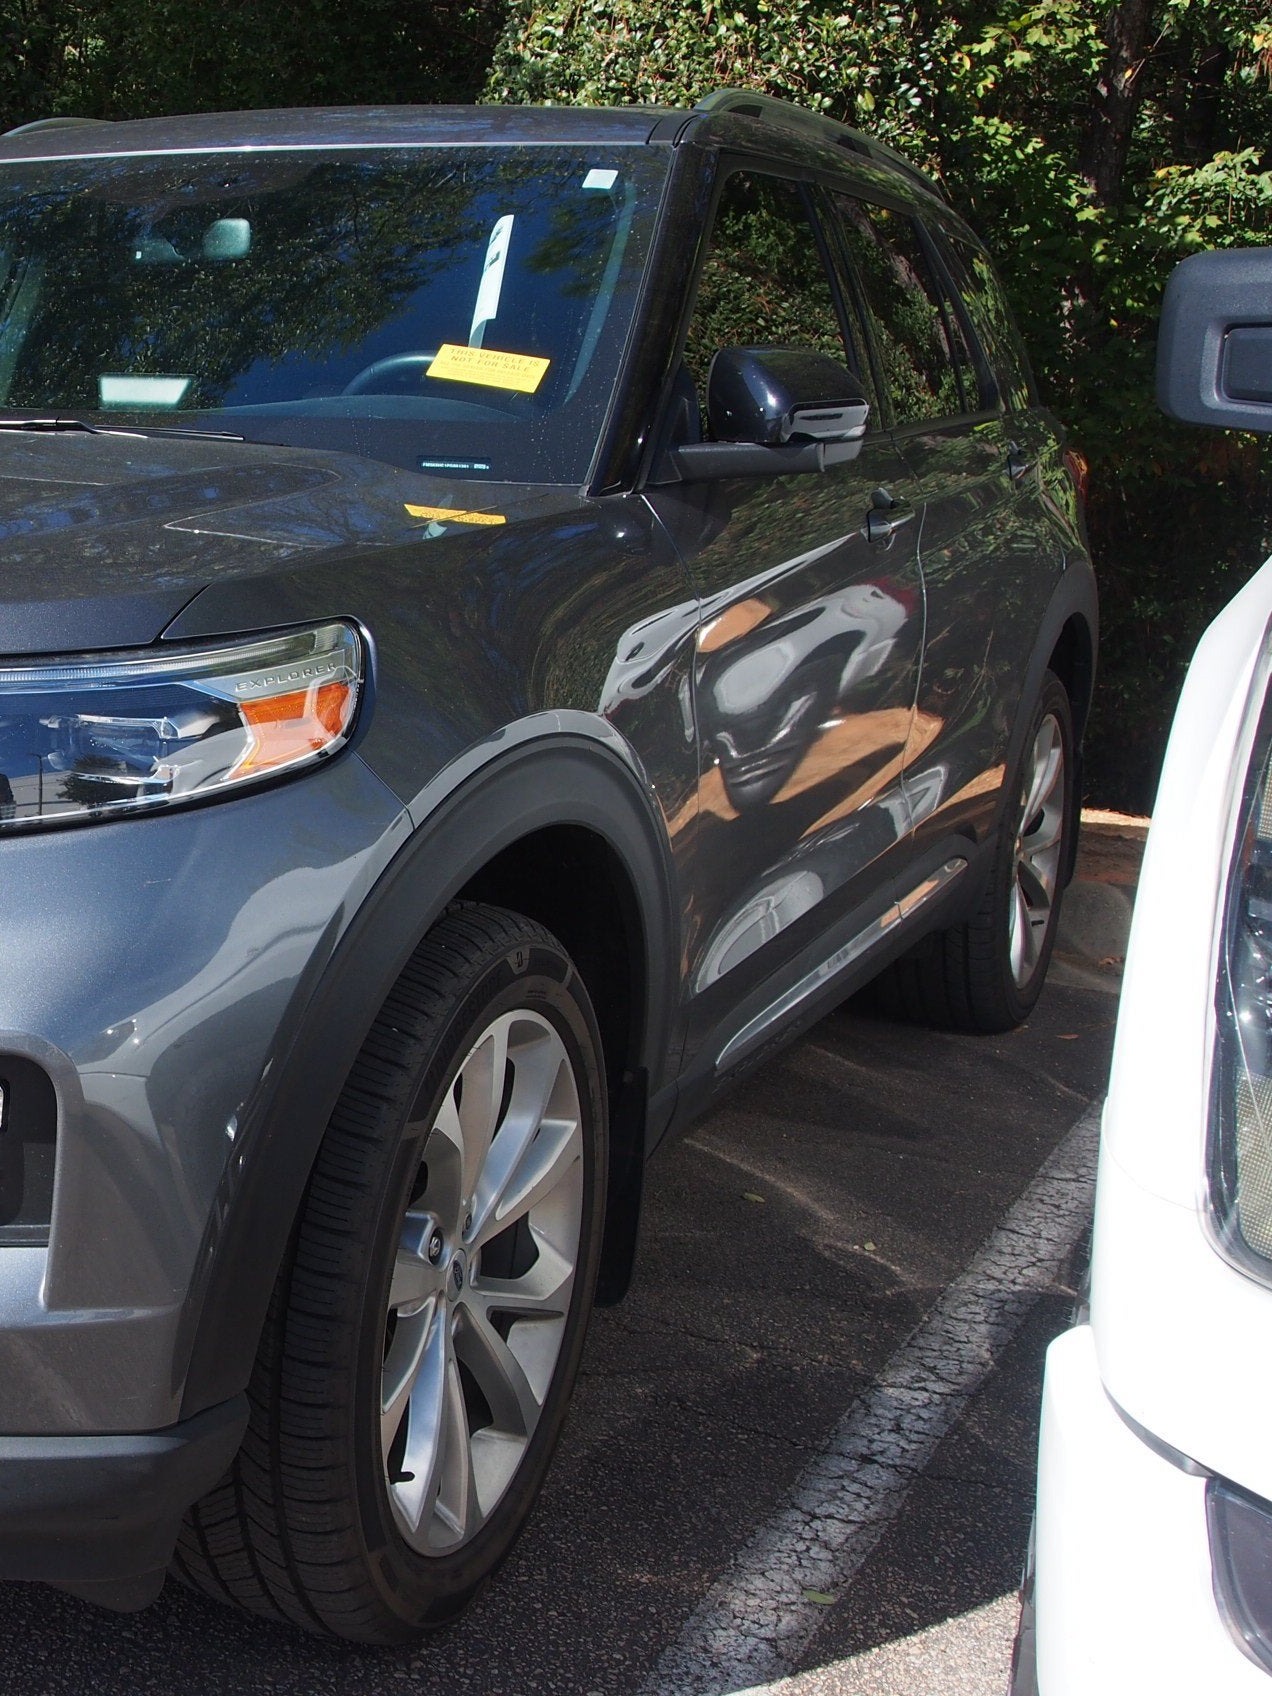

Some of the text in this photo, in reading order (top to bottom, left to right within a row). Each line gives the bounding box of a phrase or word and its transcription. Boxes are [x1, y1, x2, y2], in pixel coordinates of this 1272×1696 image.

[451, 348, 541, 367] THIS VEHICLE IS
[451, 355, 531, 372] NOT FOR SALE
[235, 662, 337, 692] EXPLORER
